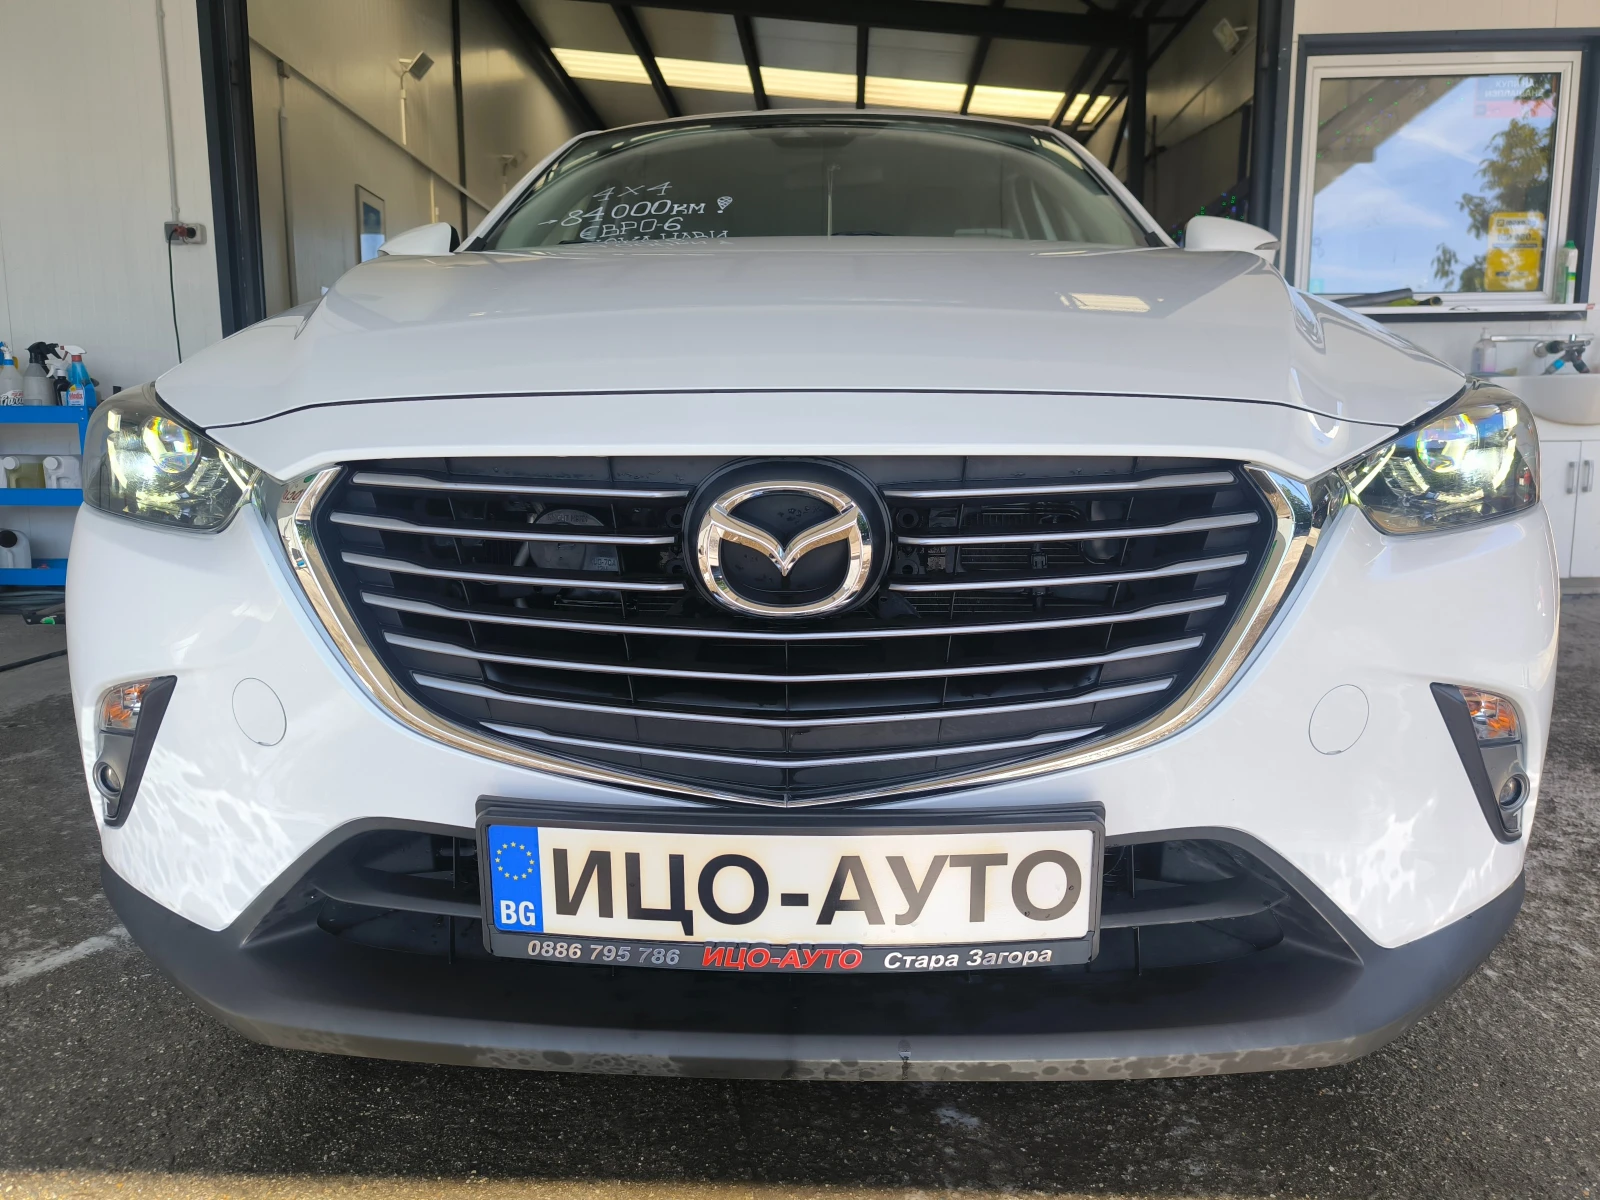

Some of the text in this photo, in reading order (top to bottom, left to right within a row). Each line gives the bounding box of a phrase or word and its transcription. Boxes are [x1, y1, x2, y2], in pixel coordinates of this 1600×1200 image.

[552, 848, 1082, 936] ИЦО-АУТО
[500, 900, 536, 926] BG
[527, 940, 1053, 970] 0886 795 786 ИЦО-АУТО Стара Загора
